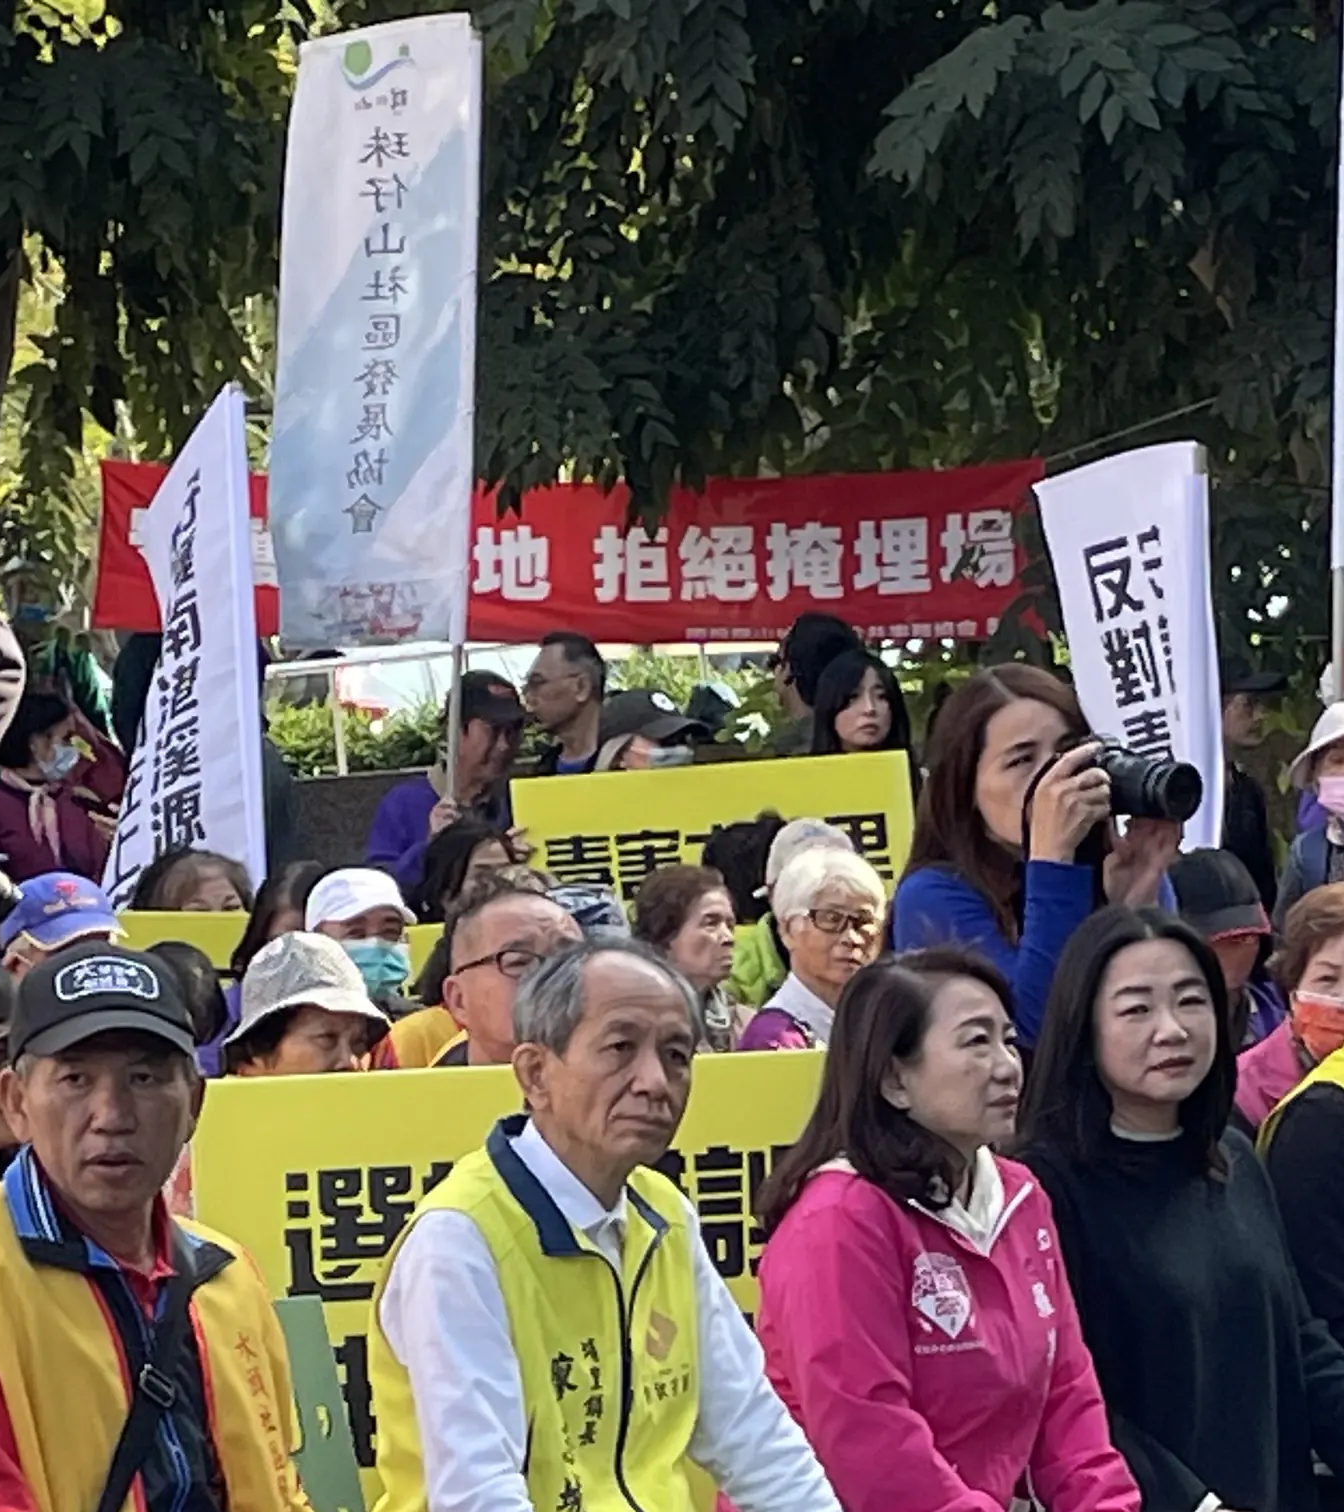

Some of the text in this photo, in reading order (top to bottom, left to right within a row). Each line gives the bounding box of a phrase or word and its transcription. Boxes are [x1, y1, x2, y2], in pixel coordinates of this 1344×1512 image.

[471, 509, 1016, 603] 地 拒絕掩埋場
